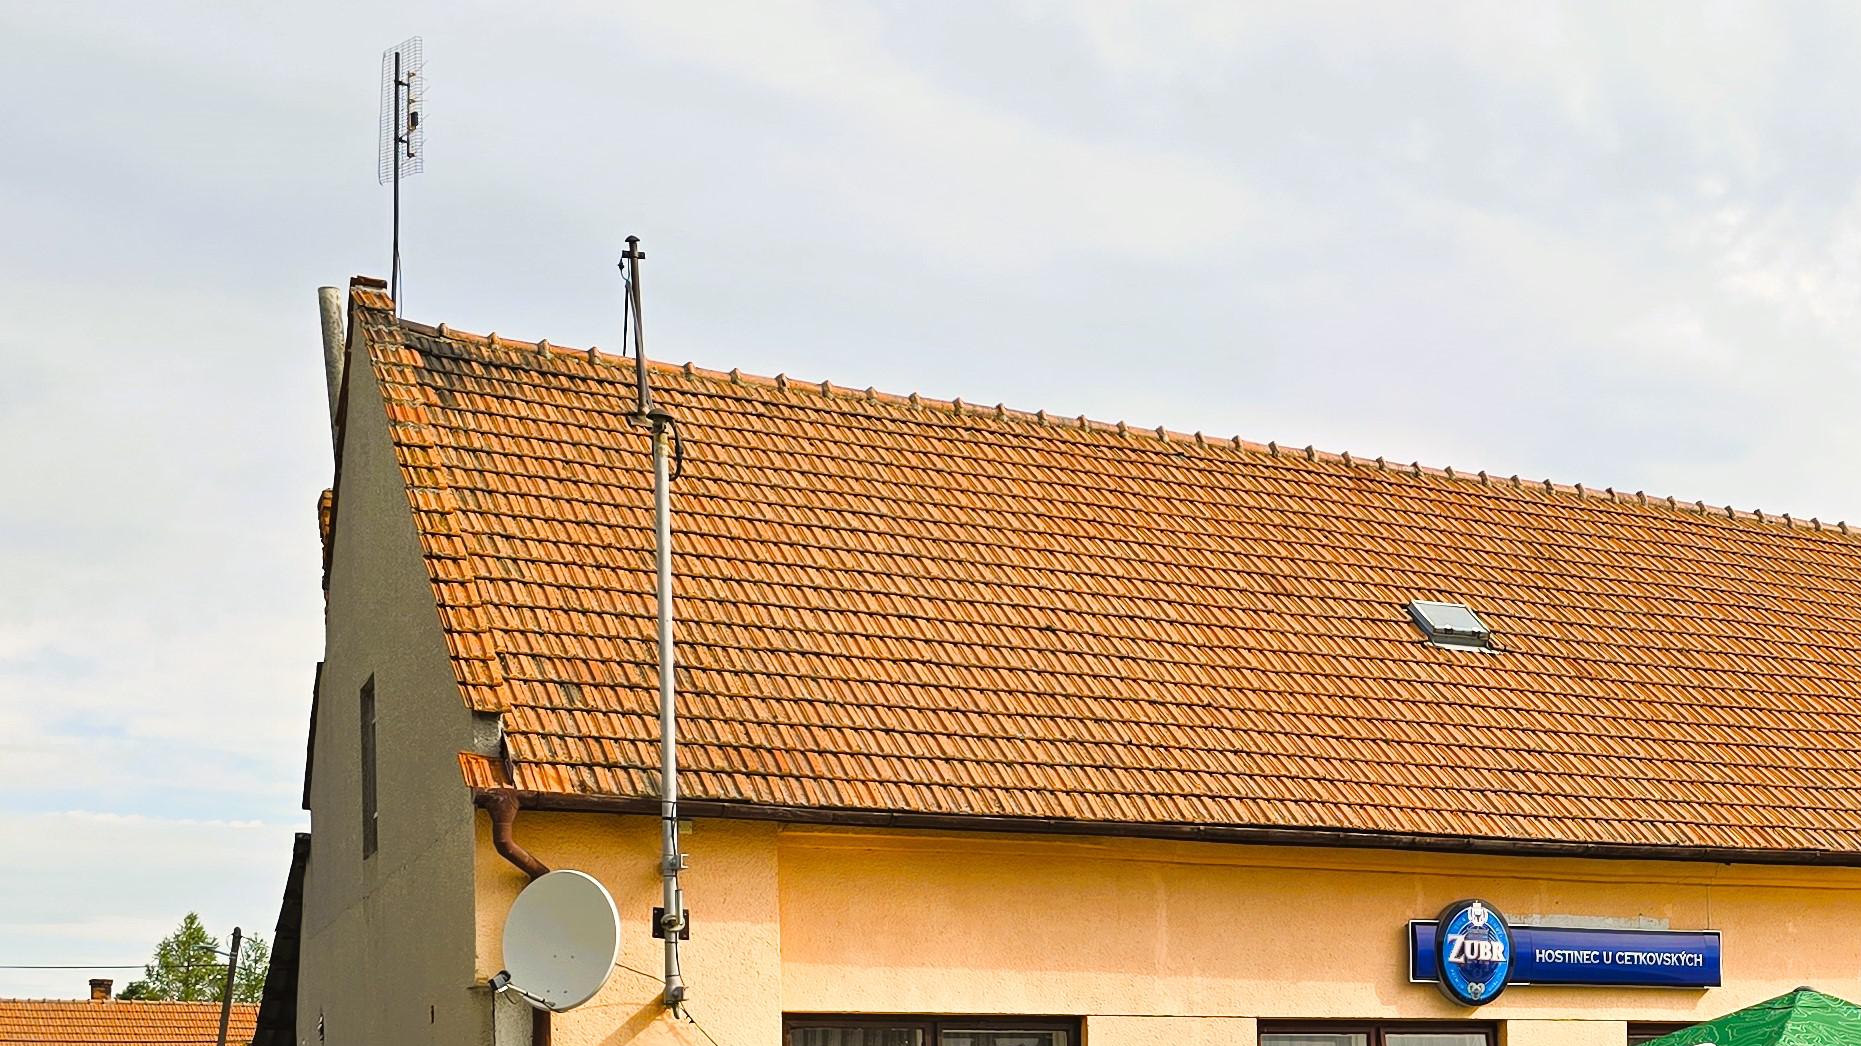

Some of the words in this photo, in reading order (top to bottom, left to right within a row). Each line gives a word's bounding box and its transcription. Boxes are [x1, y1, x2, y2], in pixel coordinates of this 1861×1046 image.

[1447, 933, 1508, 963] ZUBR
[1535, 949, 1599, 964] HOSTINEC
[1603, 951, 1611, 964] U
[1615, 950, 1703, 966] CETKOVSKÝCH
